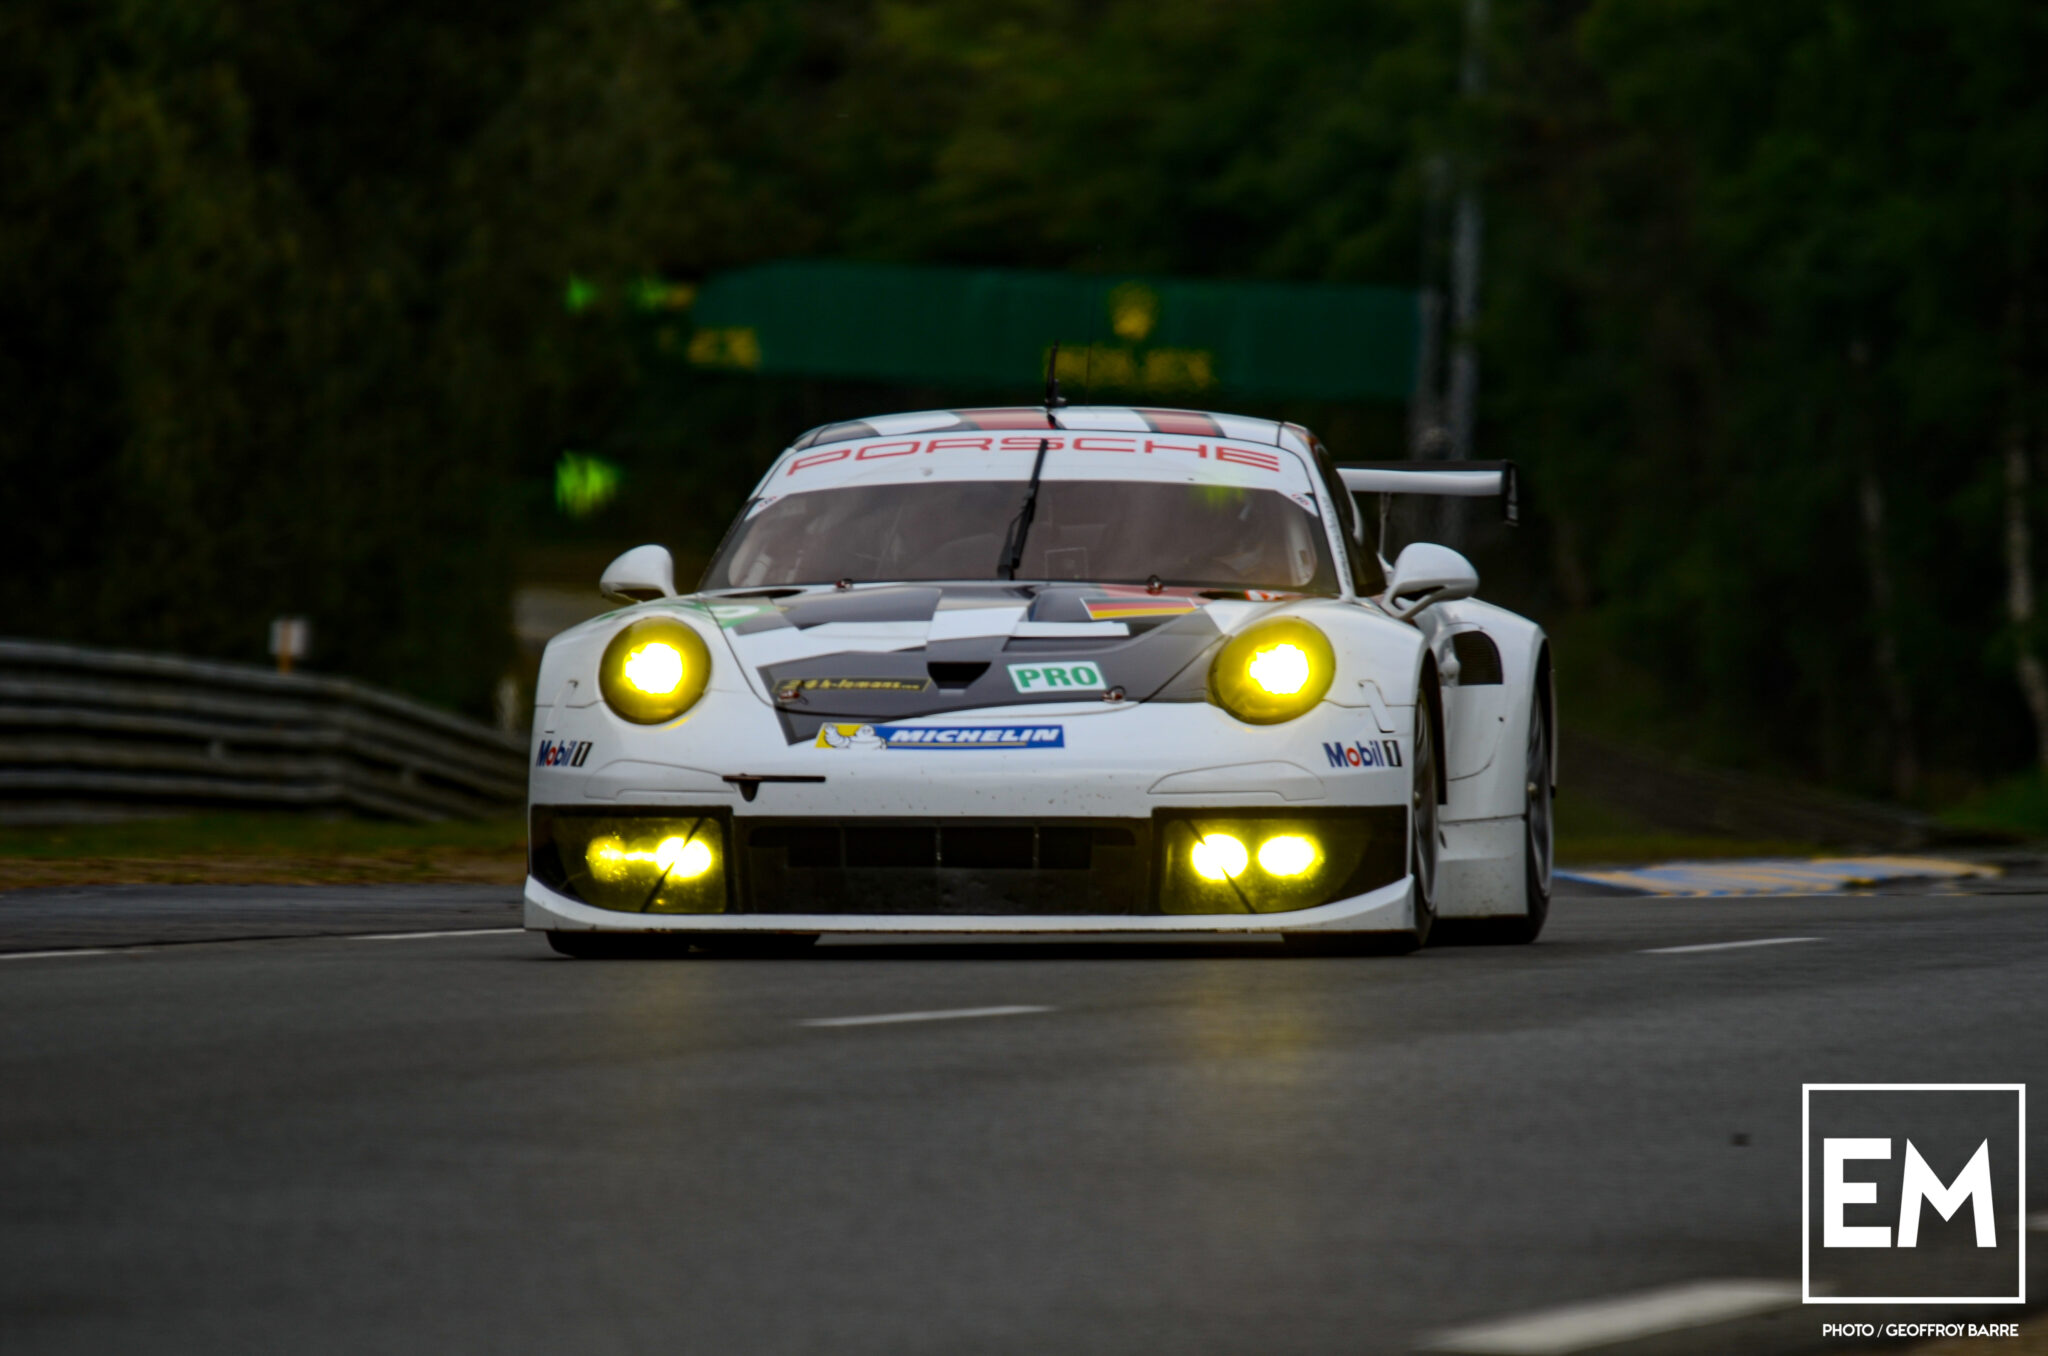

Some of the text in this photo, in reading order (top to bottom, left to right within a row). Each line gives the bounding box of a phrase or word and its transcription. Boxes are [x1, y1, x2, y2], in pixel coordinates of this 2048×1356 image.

[787, 436, 1280, 476] PORSCHE
[1015, 666, 1099, 689] PRO
[890, 728, 1060, 743] MICHELIN
[536, 739, 593, 767] Mobil 1
[1322, 740, 1402, 768] Mobil 1
